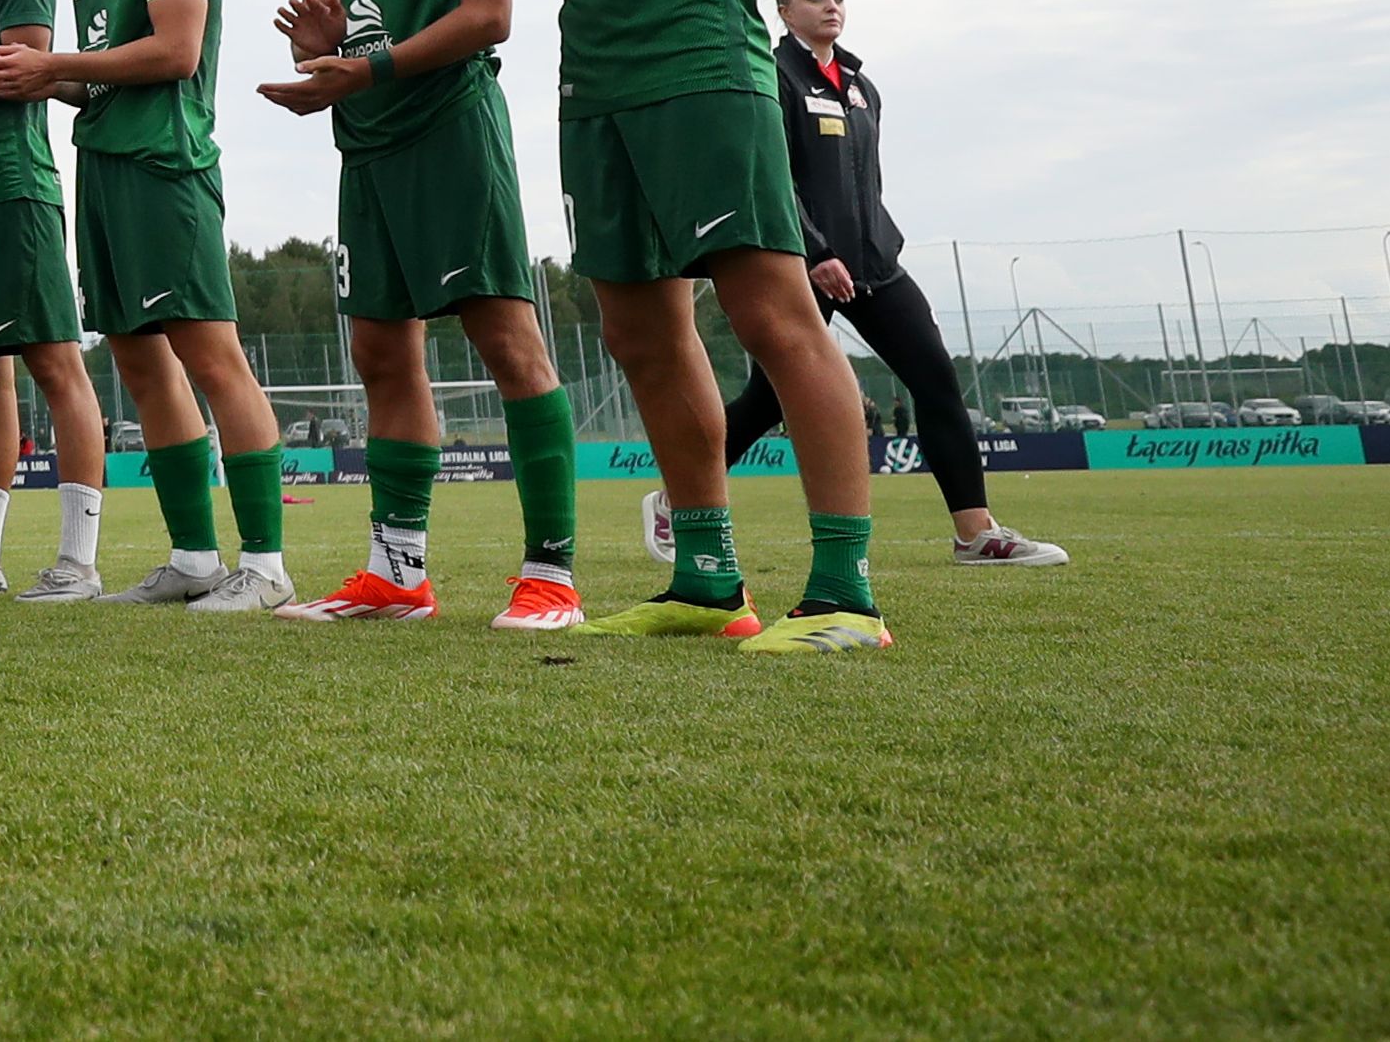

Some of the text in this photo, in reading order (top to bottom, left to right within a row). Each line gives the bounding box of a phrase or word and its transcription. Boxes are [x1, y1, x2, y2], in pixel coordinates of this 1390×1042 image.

[440, 451, 486, 464] ENTRALNA
[1126, 430, 1320, 467] Łączy nas piłka
